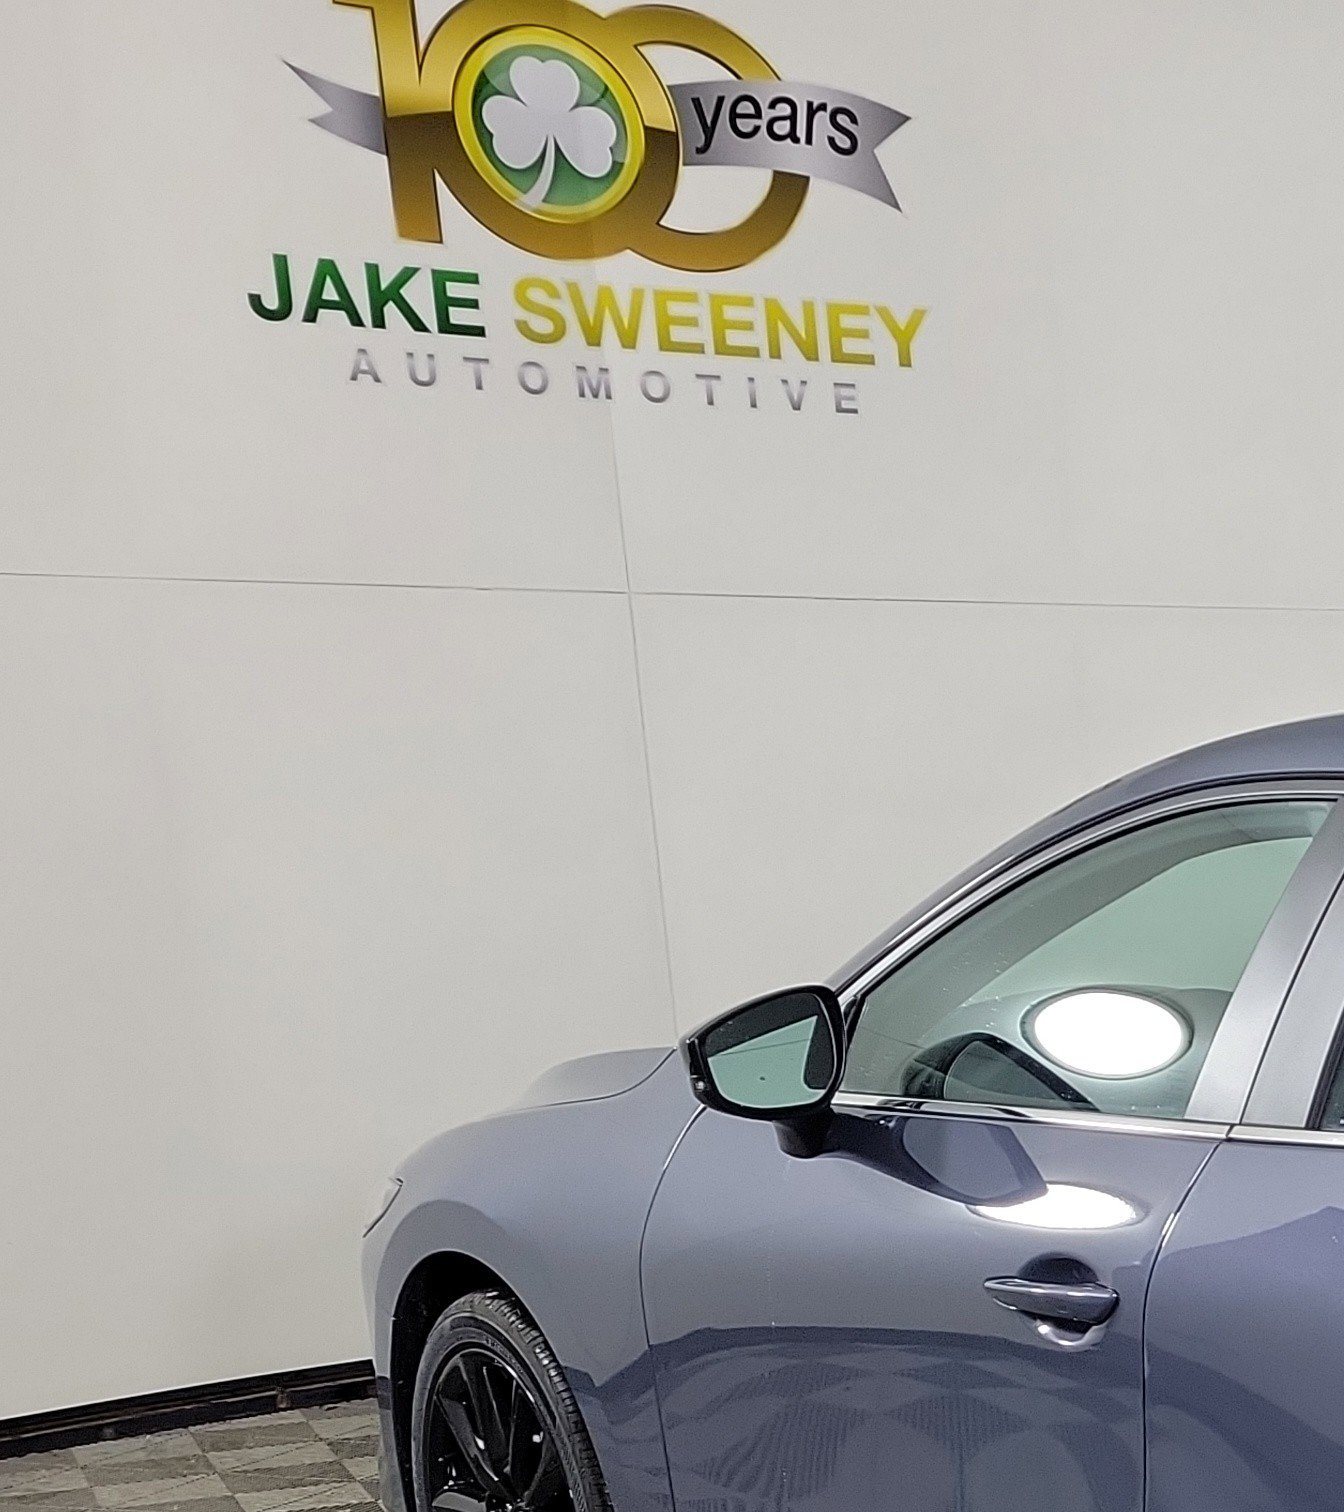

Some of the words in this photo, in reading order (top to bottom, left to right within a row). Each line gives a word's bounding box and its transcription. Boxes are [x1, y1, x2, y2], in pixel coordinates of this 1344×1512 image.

[690, 92, 860, 157] years
[247, 253, 487, 339] JAKE
[512, 276, 929, 368] SWEENEY
[350, 348, 861, 415] AUTOMOTIVE
